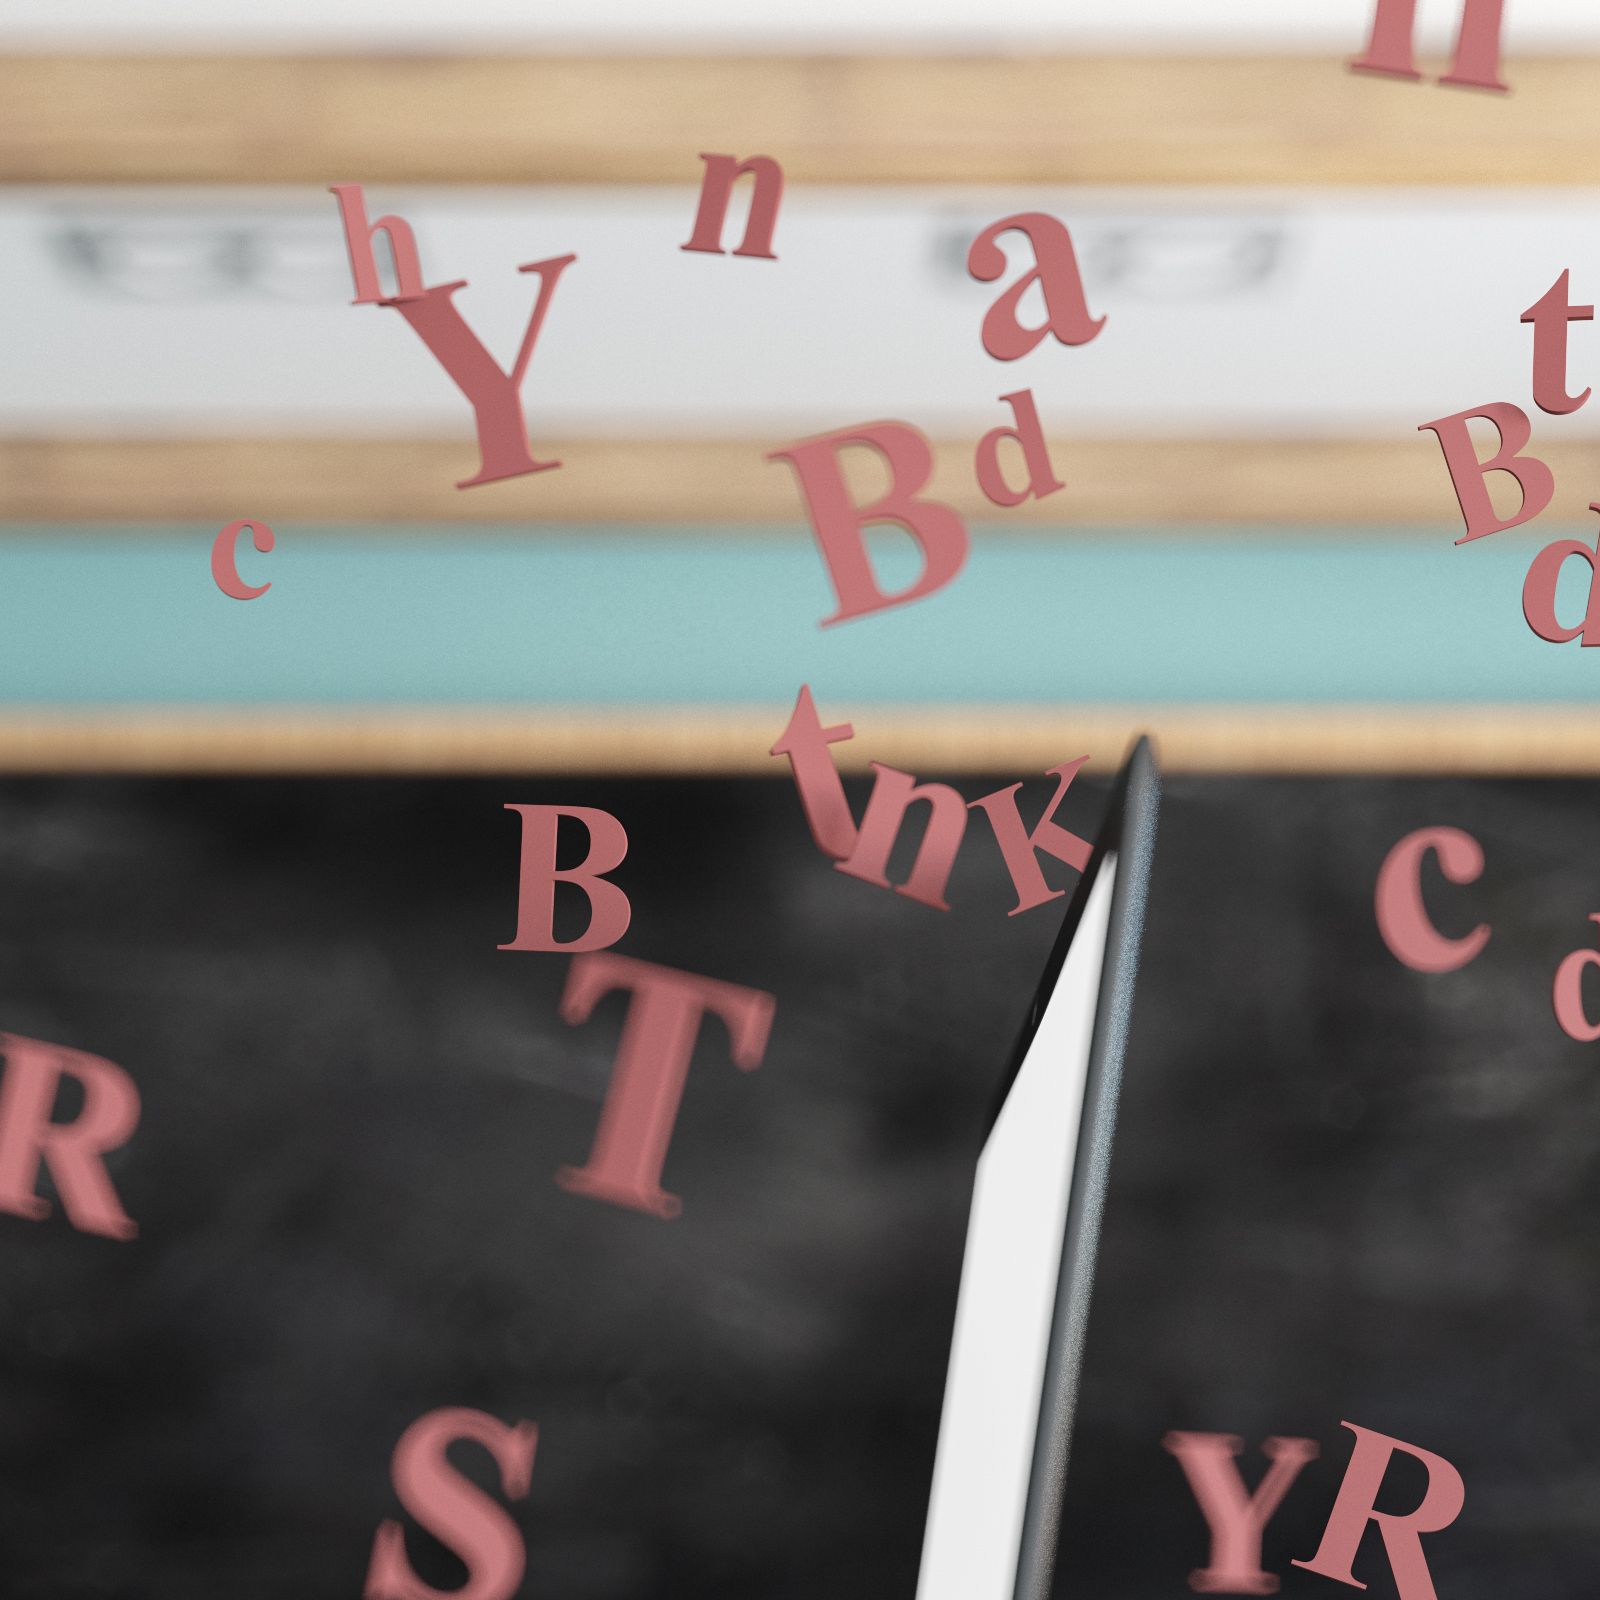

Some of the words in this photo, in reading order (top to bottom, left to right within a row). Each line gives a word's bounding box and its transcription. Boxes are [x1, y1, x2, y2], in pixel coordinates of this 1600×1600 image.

[329, 183, 429, 305] h
[682, 153, 785, 260] n
[966, 212, 1107, 361] a
[1519, 267, 1595, 416] t
[377, 252, 578, 490] Y
[763, 418, 971, 629] B
[975, 388, 1066, 509] d
[1417, 401, 1556, 546] B
[210, 518, 275, 601] c
[769, 683, 855, 862] t
[833, 760, 968, 913] n
[966, 754, 1097, 917] K
[497, 803, 632, 954] B
[1374, 826, 1491, 974] c
[554, 950, 778, 1222] T
[1166, 1431, 1312, 1595] Y
